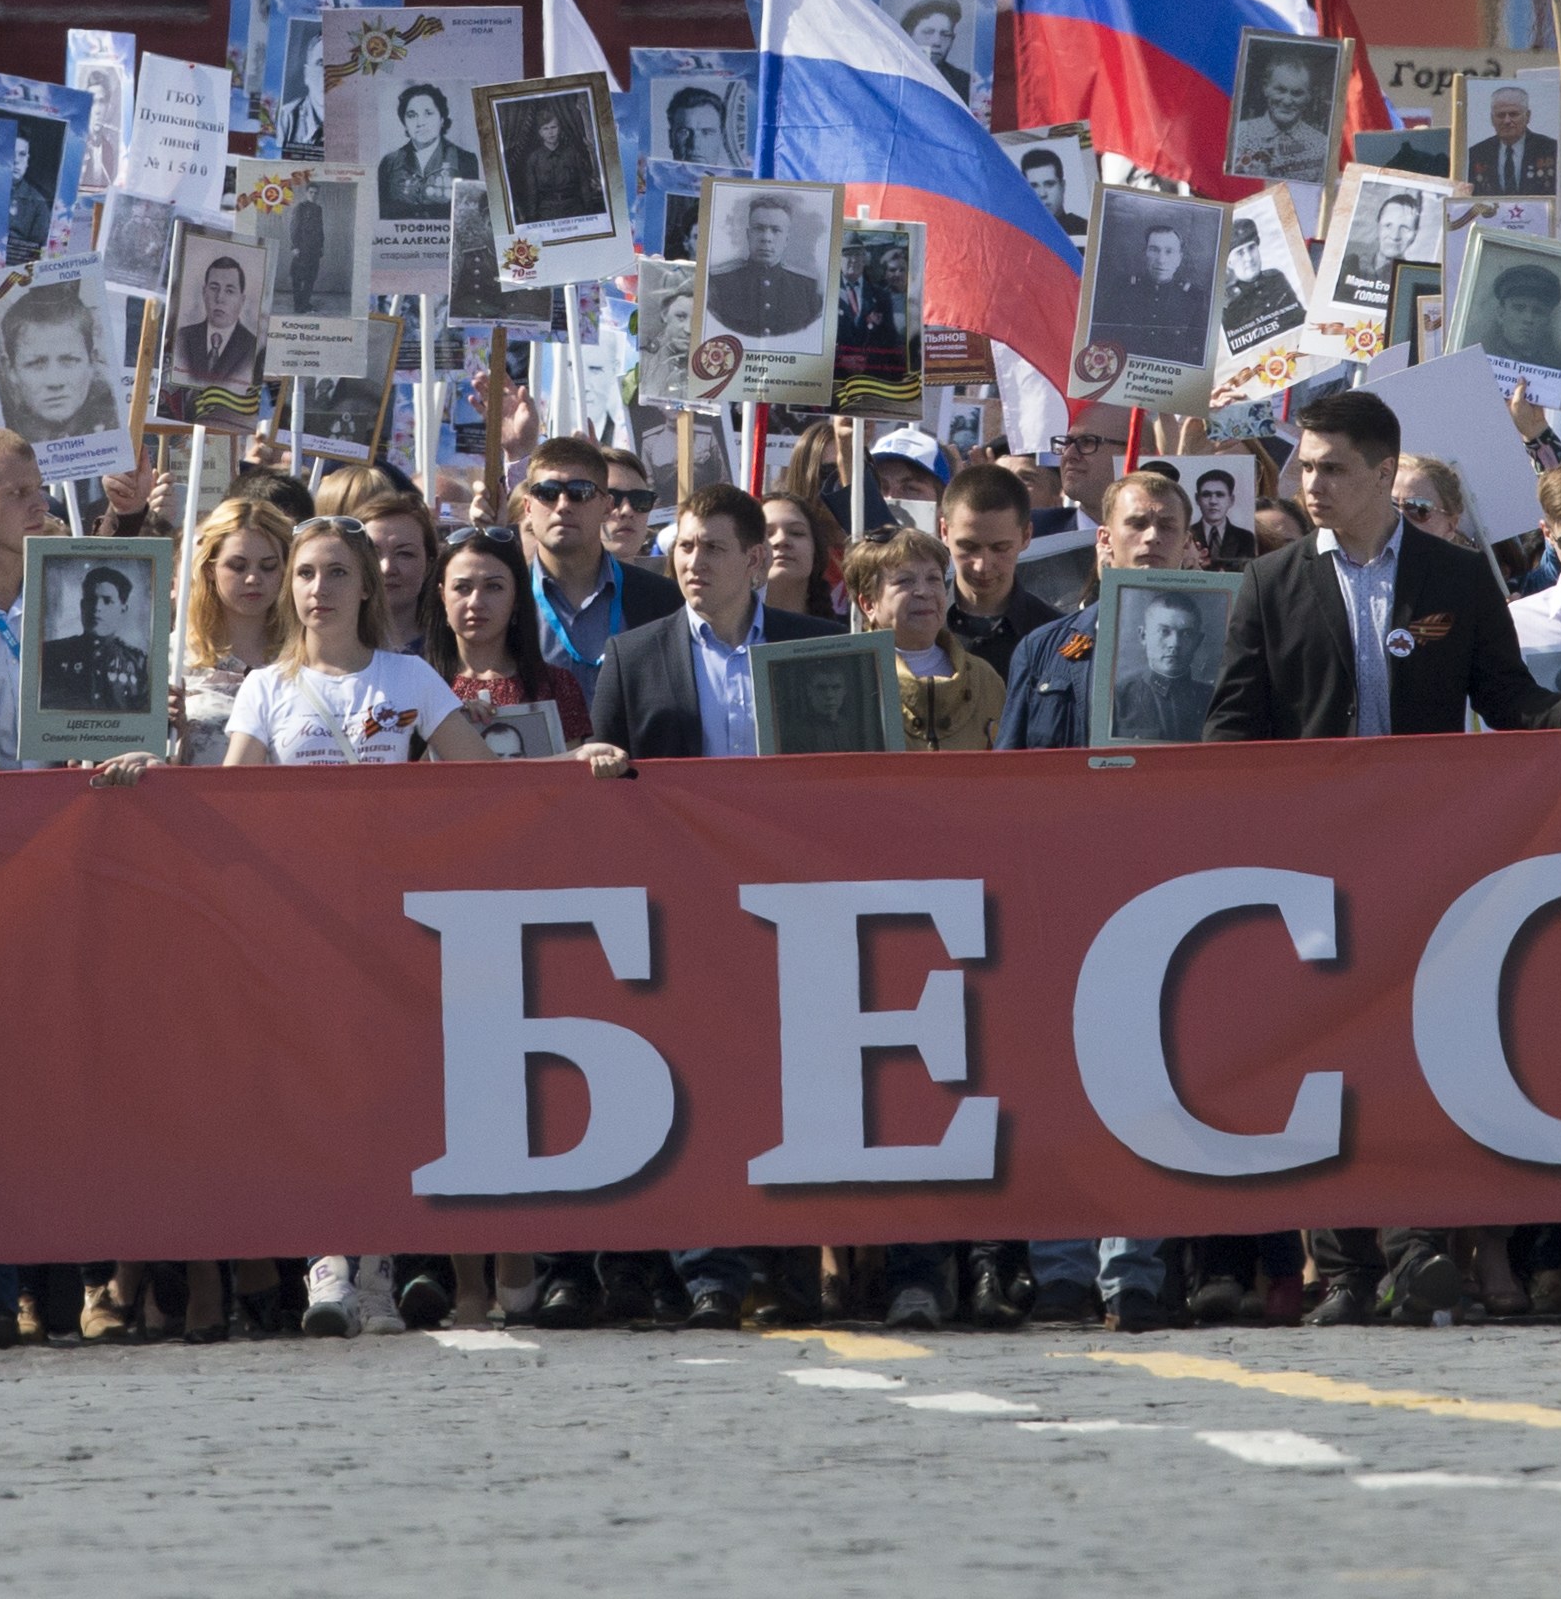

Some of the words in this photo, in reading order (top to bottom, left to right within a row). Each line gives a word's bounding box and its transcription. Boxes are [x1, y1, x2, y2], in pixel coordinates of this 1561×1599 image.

[452, 18, 512, 26] БЕССМЕРТНЫЙ
[1389, 57, 1502, 96] Горд
[165, 89, 206, 106] ГБОУ
[139, 106, 226, 135] Пушкинский
[158, 135, 200, 154] лицей
[143, 155, 161, 170] №
[394, 223, 451, 234] ТРОФИМО
[380, 251, 420, 261] старший
[38, 255, 99, 273] БЕССМЕРТНЫЙ
[58, 268, 82, 280] ПОЛК
[512, 268, 525, 278] 70
[281, 321, 320, 332] Клочков
[299, 332, 353, 343] Васильевич
[745, 352, 797, 365] МИРОНОВ
[745, 364, 768, 377] Пётр
[1128, 359, 1182, 377] БУРЛАКОВ
[1126, 370, 1174, 386] Григорий
[1124, 382, 1174, 397] Глебович
[45, 438, 85, 453] СТУПИН
[50, 446, 119, 464] Лаврентьевич
[66, 719, 121, 732] ЦВЕТКОВ
[78, 733, 146, 744] Николаевич
